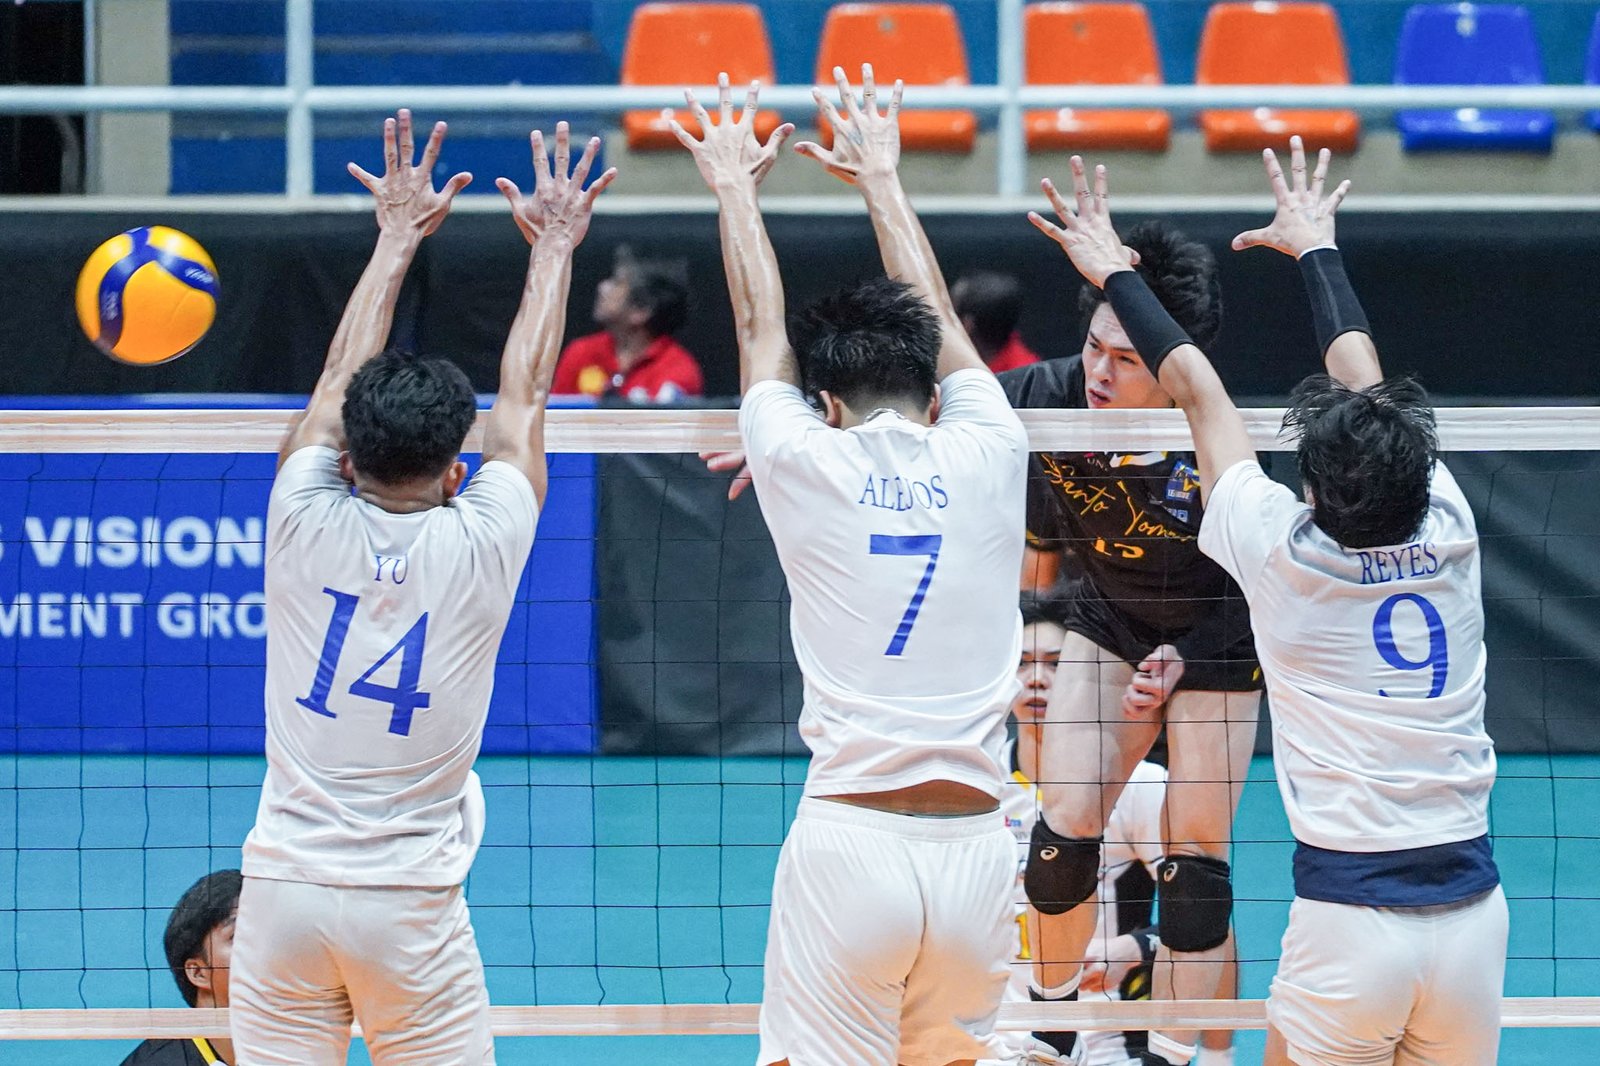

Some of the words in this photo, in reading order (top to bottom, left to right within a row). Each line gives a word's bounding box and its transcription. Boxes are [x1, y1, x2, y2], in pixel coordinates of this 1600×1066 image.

[858, 473, 949, 512] ALEJOS
[24, 515, 263, 568] VISION
[1356, 542, 1439, 585] REYES
[374, 554, 409, 585] YU
[869, 533, 943, 656] 7
[157, 592, 268, 639] GRO
[295, 586, 431, 737] 14
[1372, 592, 1449, 699] 9
